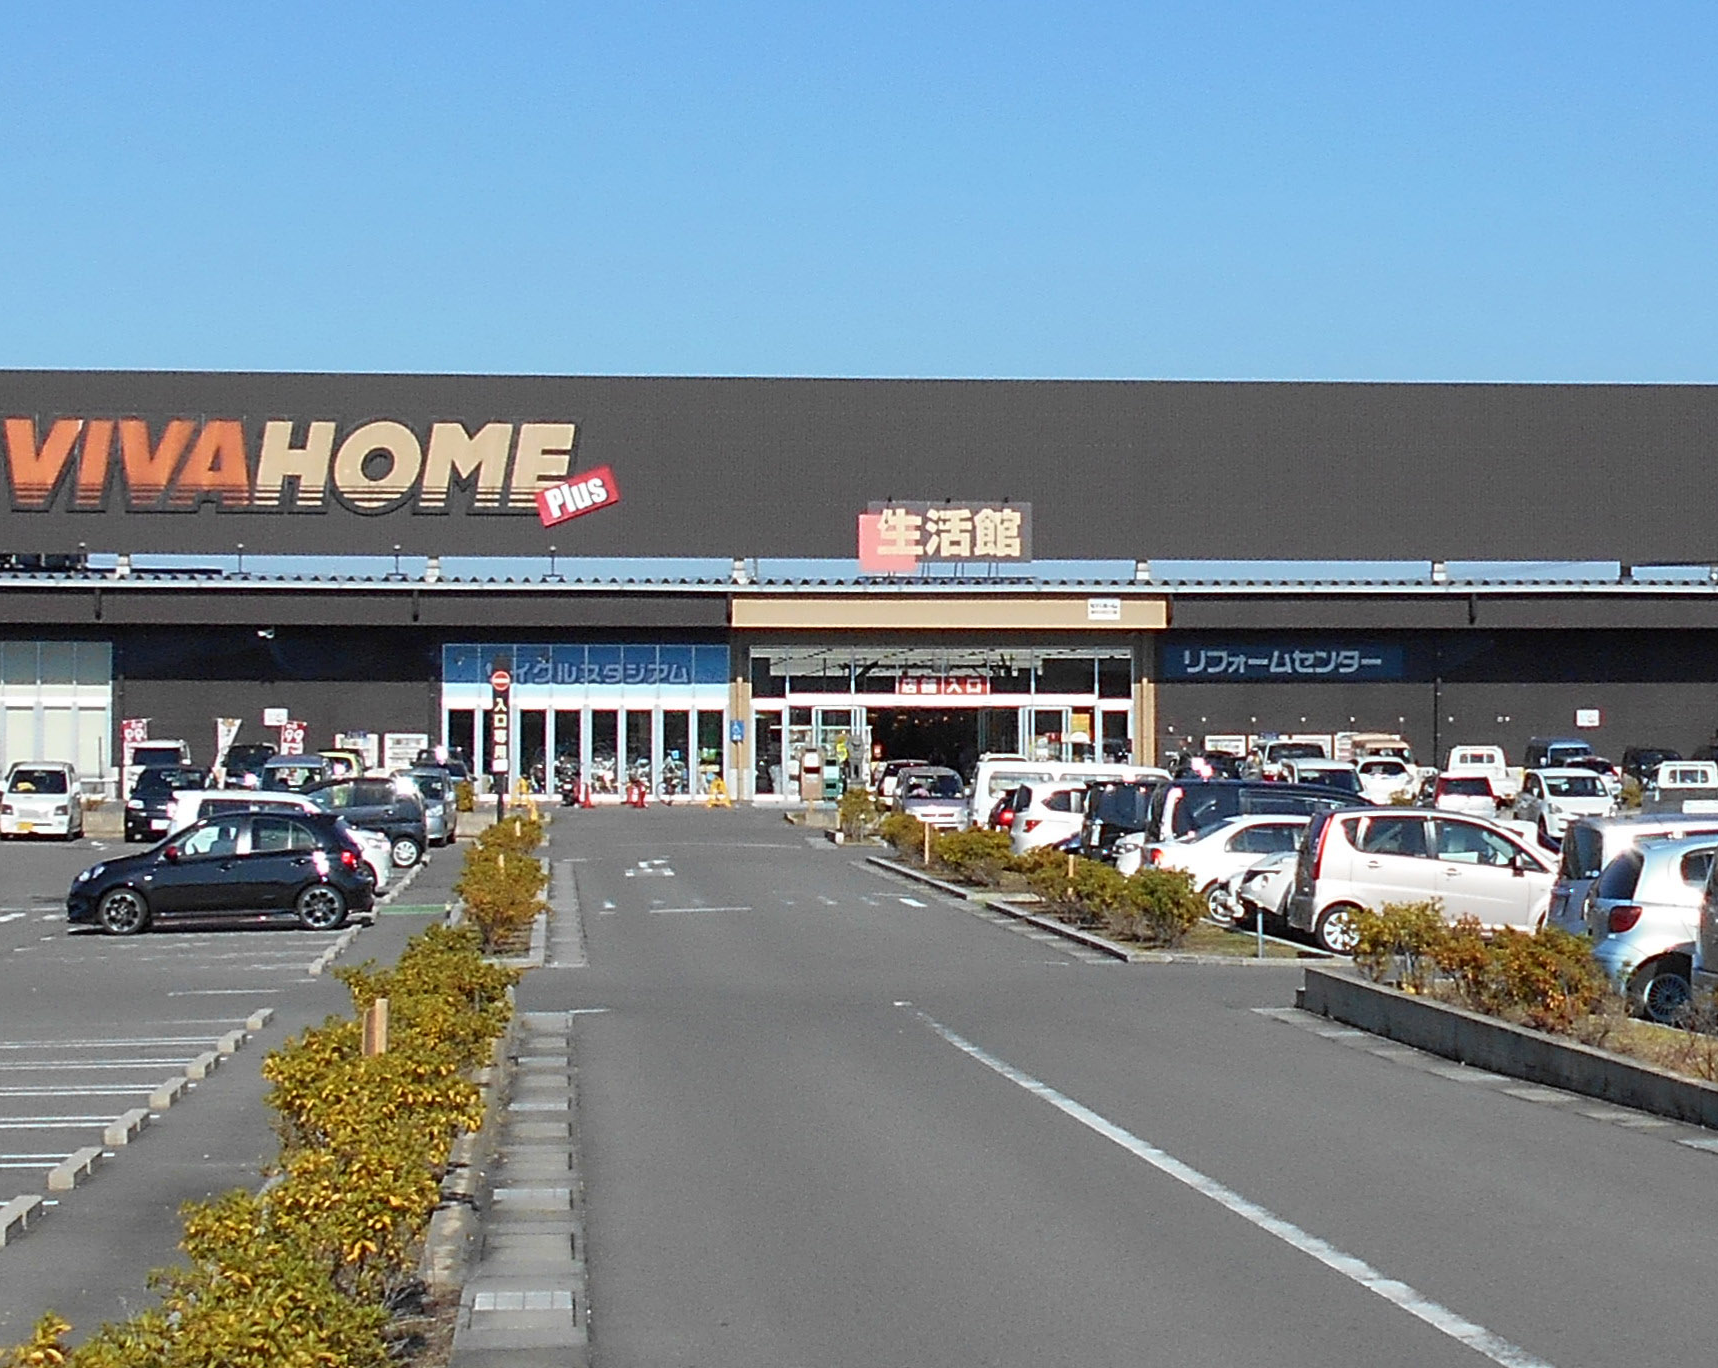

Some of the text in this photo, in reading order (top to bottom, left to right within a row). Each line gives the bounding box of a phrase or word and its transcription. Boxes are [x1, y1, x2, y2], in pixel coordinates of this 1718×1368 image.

[3, 418, 576, 508] VIVAHOME
[544, 478, 607, 518] Plus
[877, 508, 1021, 556] 生活館
[485, 660, 689, 683] イクルスタジアム
[1184, 650, 1382, 673] リフォームセンター
[901, 678, 982, 694] 店舗入口
[493, 697, 508, 759] 入口専用
